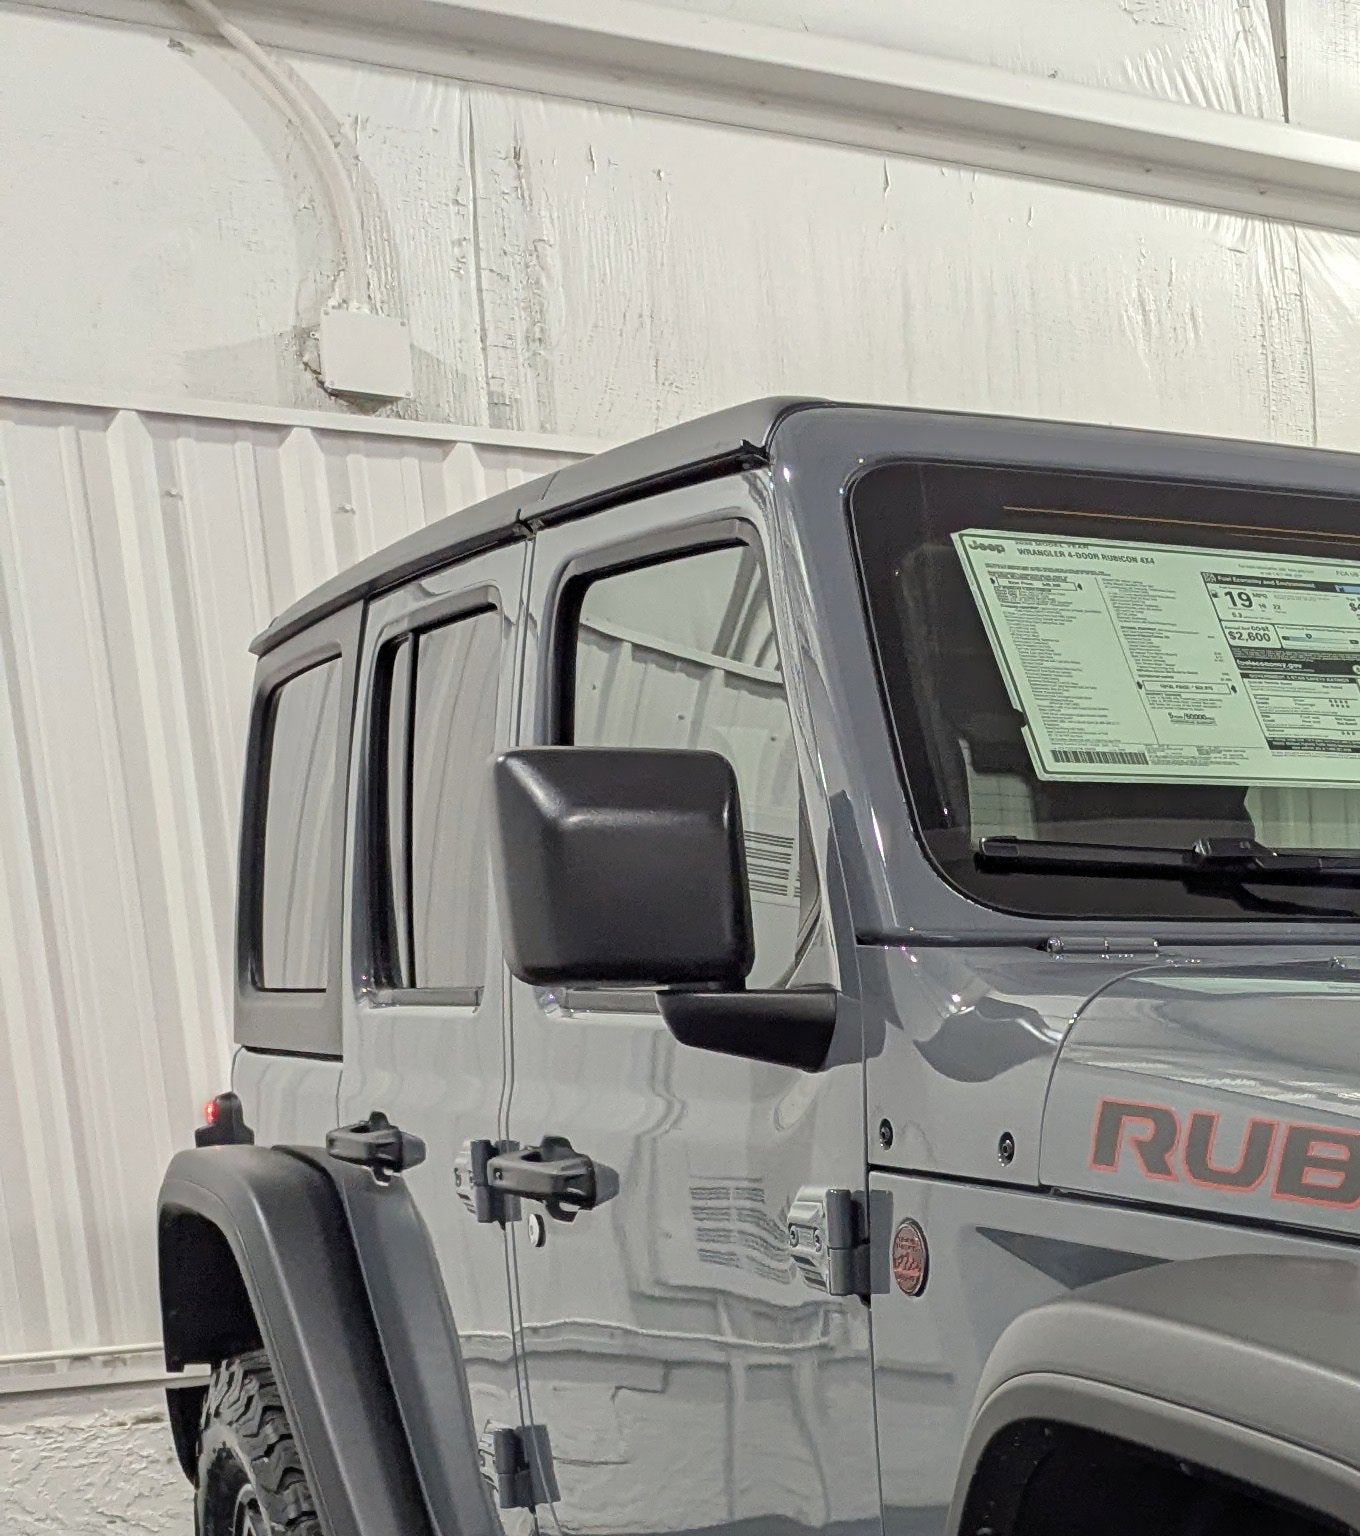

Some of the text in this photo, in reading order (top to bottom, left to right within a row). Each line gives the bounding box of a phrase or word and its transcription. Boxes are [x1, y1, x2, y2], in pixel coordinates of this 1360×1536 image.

[968, 540, 1006, 554] Jeep
[1016, 547, 1066, 558] WRANGLER
[1067, 551, 1100, 561] 4-DOOR
[1100, 553, 1139, 564] RUBICON
[1223, 590, 1255, 609] 19
[1227, 630, 1272, 643] $2,600
